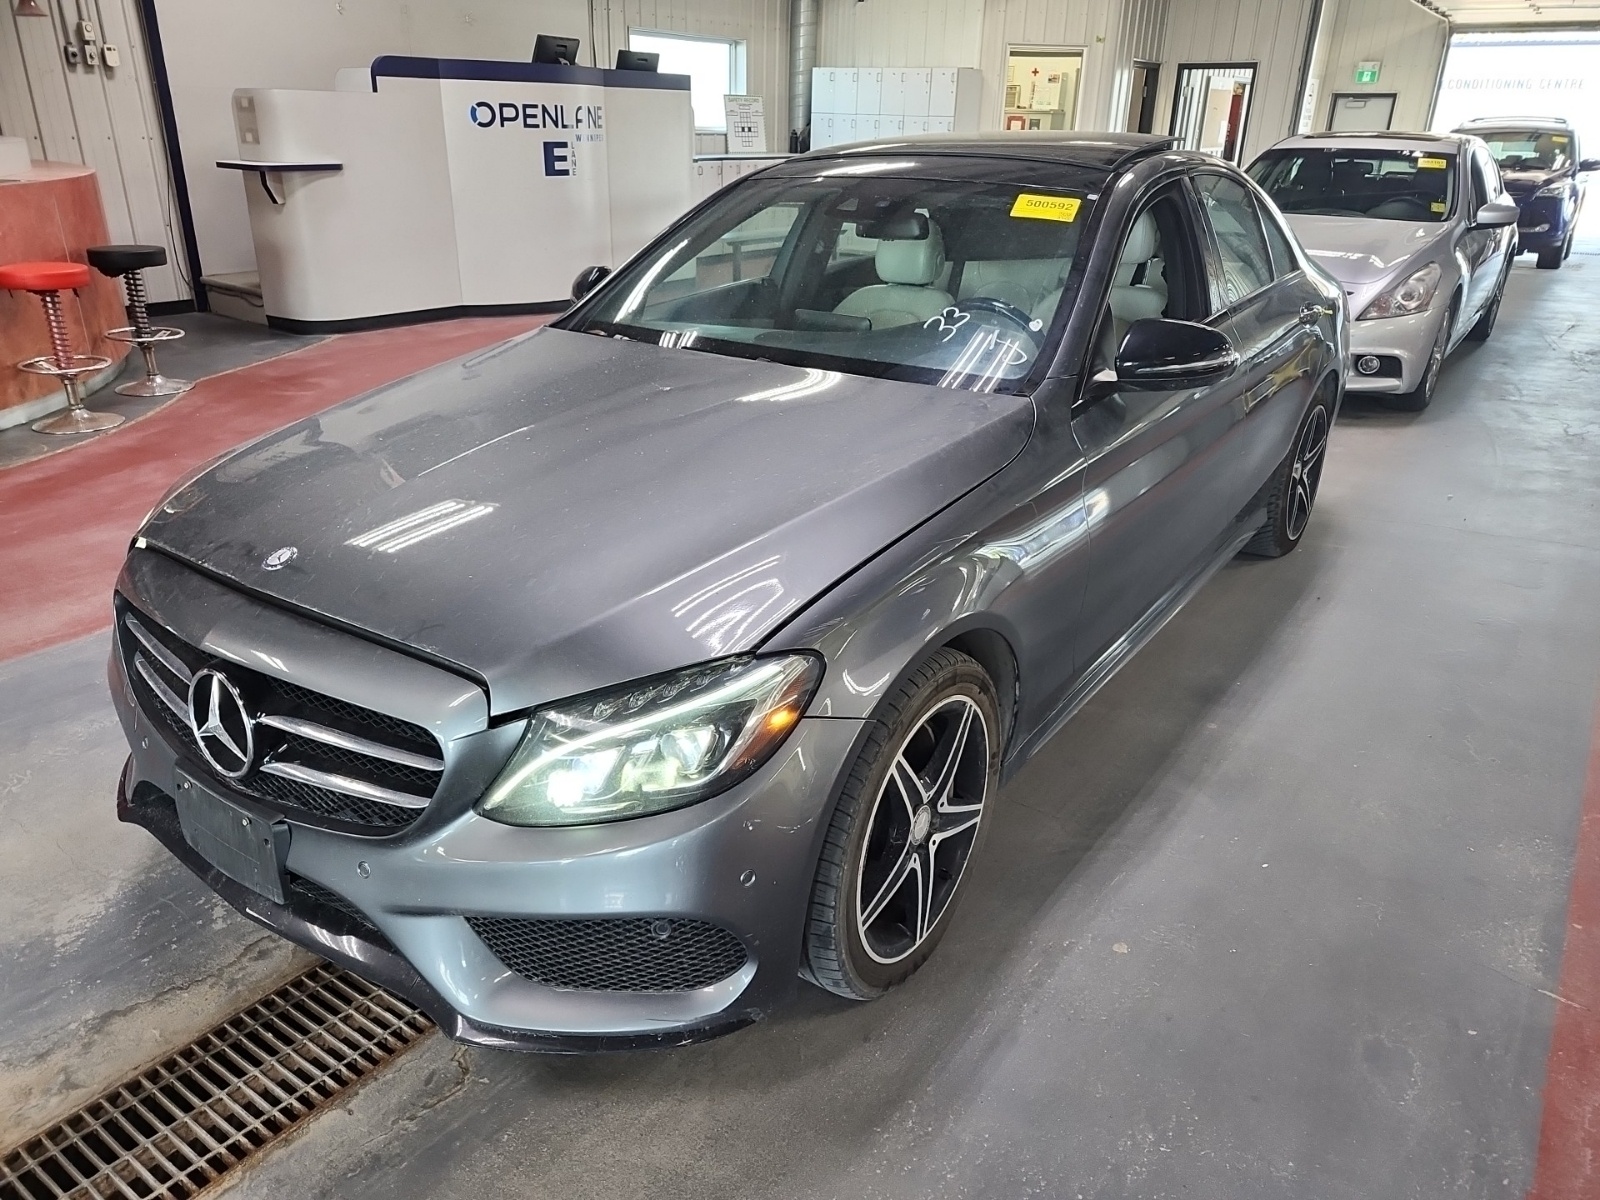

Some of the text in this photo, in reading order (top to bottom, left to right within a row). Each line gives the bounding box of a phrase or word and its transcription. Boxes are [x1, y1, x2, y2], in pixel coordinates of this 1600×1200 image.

[1442, 78, 1585, 90] CONDITIONING CENTRE
[470, 101, 603, 129] OPENLANE
[1026, 199, 1074, 211] 500592
